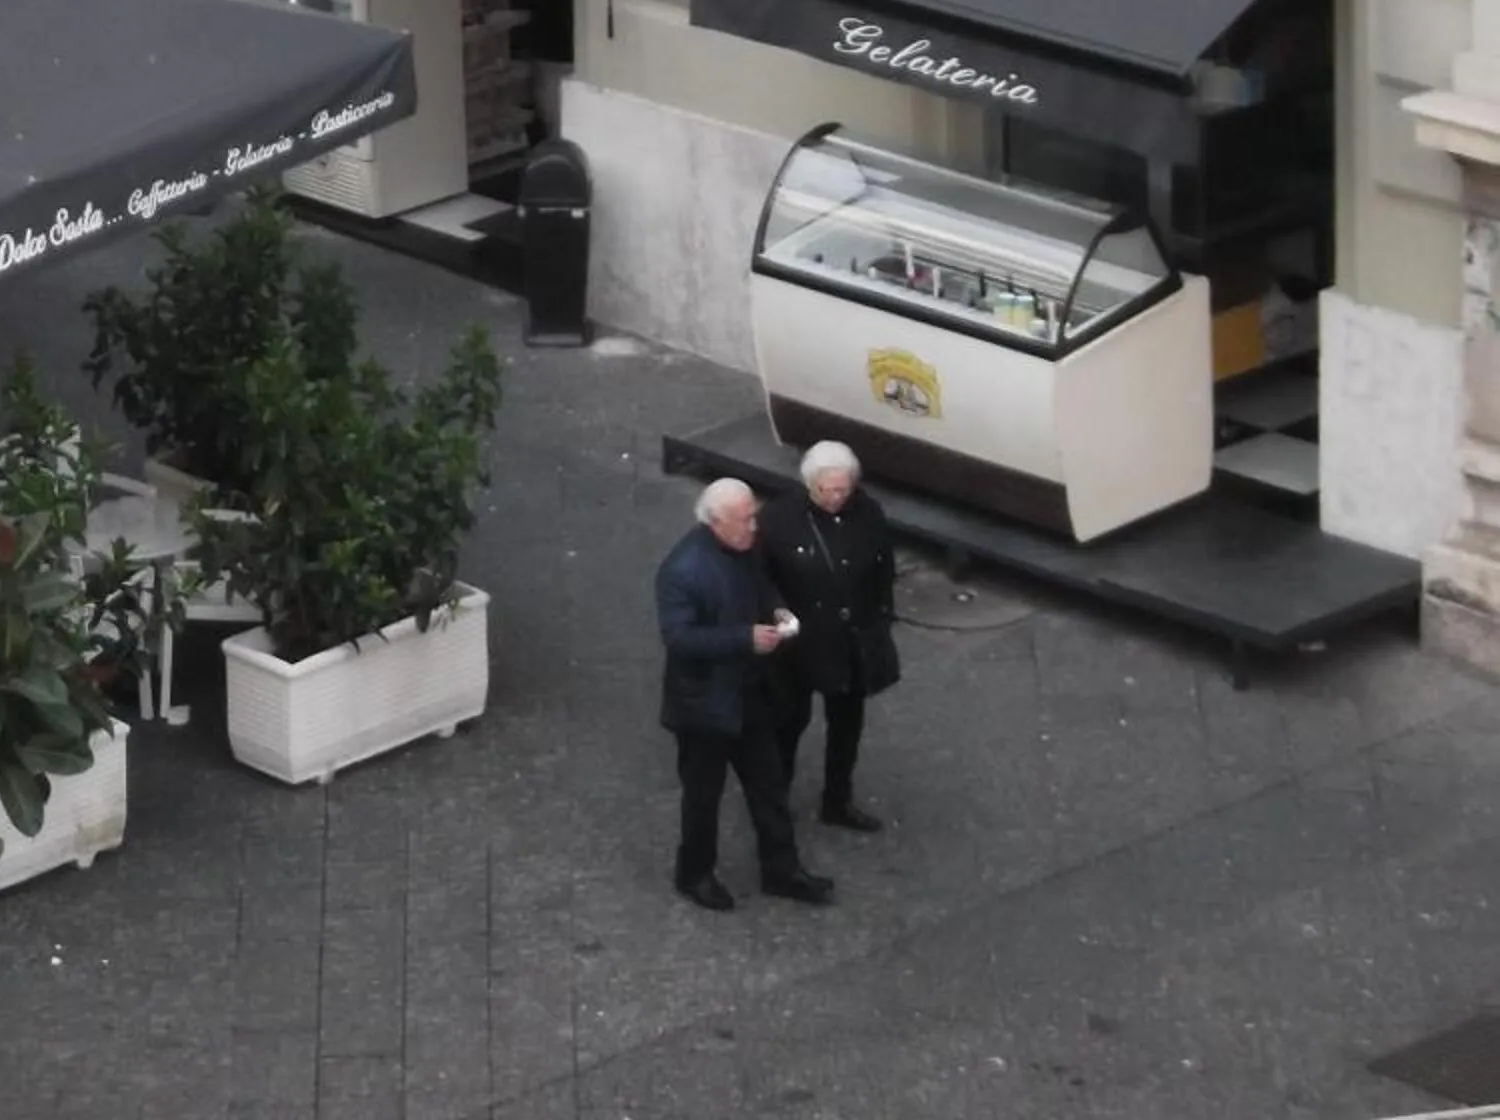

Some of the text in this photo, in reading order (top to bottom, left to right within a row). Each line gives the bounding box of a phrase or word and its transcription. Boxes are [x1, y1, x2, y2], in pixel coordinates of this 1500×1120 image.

[832, 17, 1040, 106] Gelateria
[128, 171, 208, 219] Caffetteria
[224, 134, 294, 177] Gelateria
[311, 89, 395, 139] Pasticceria
